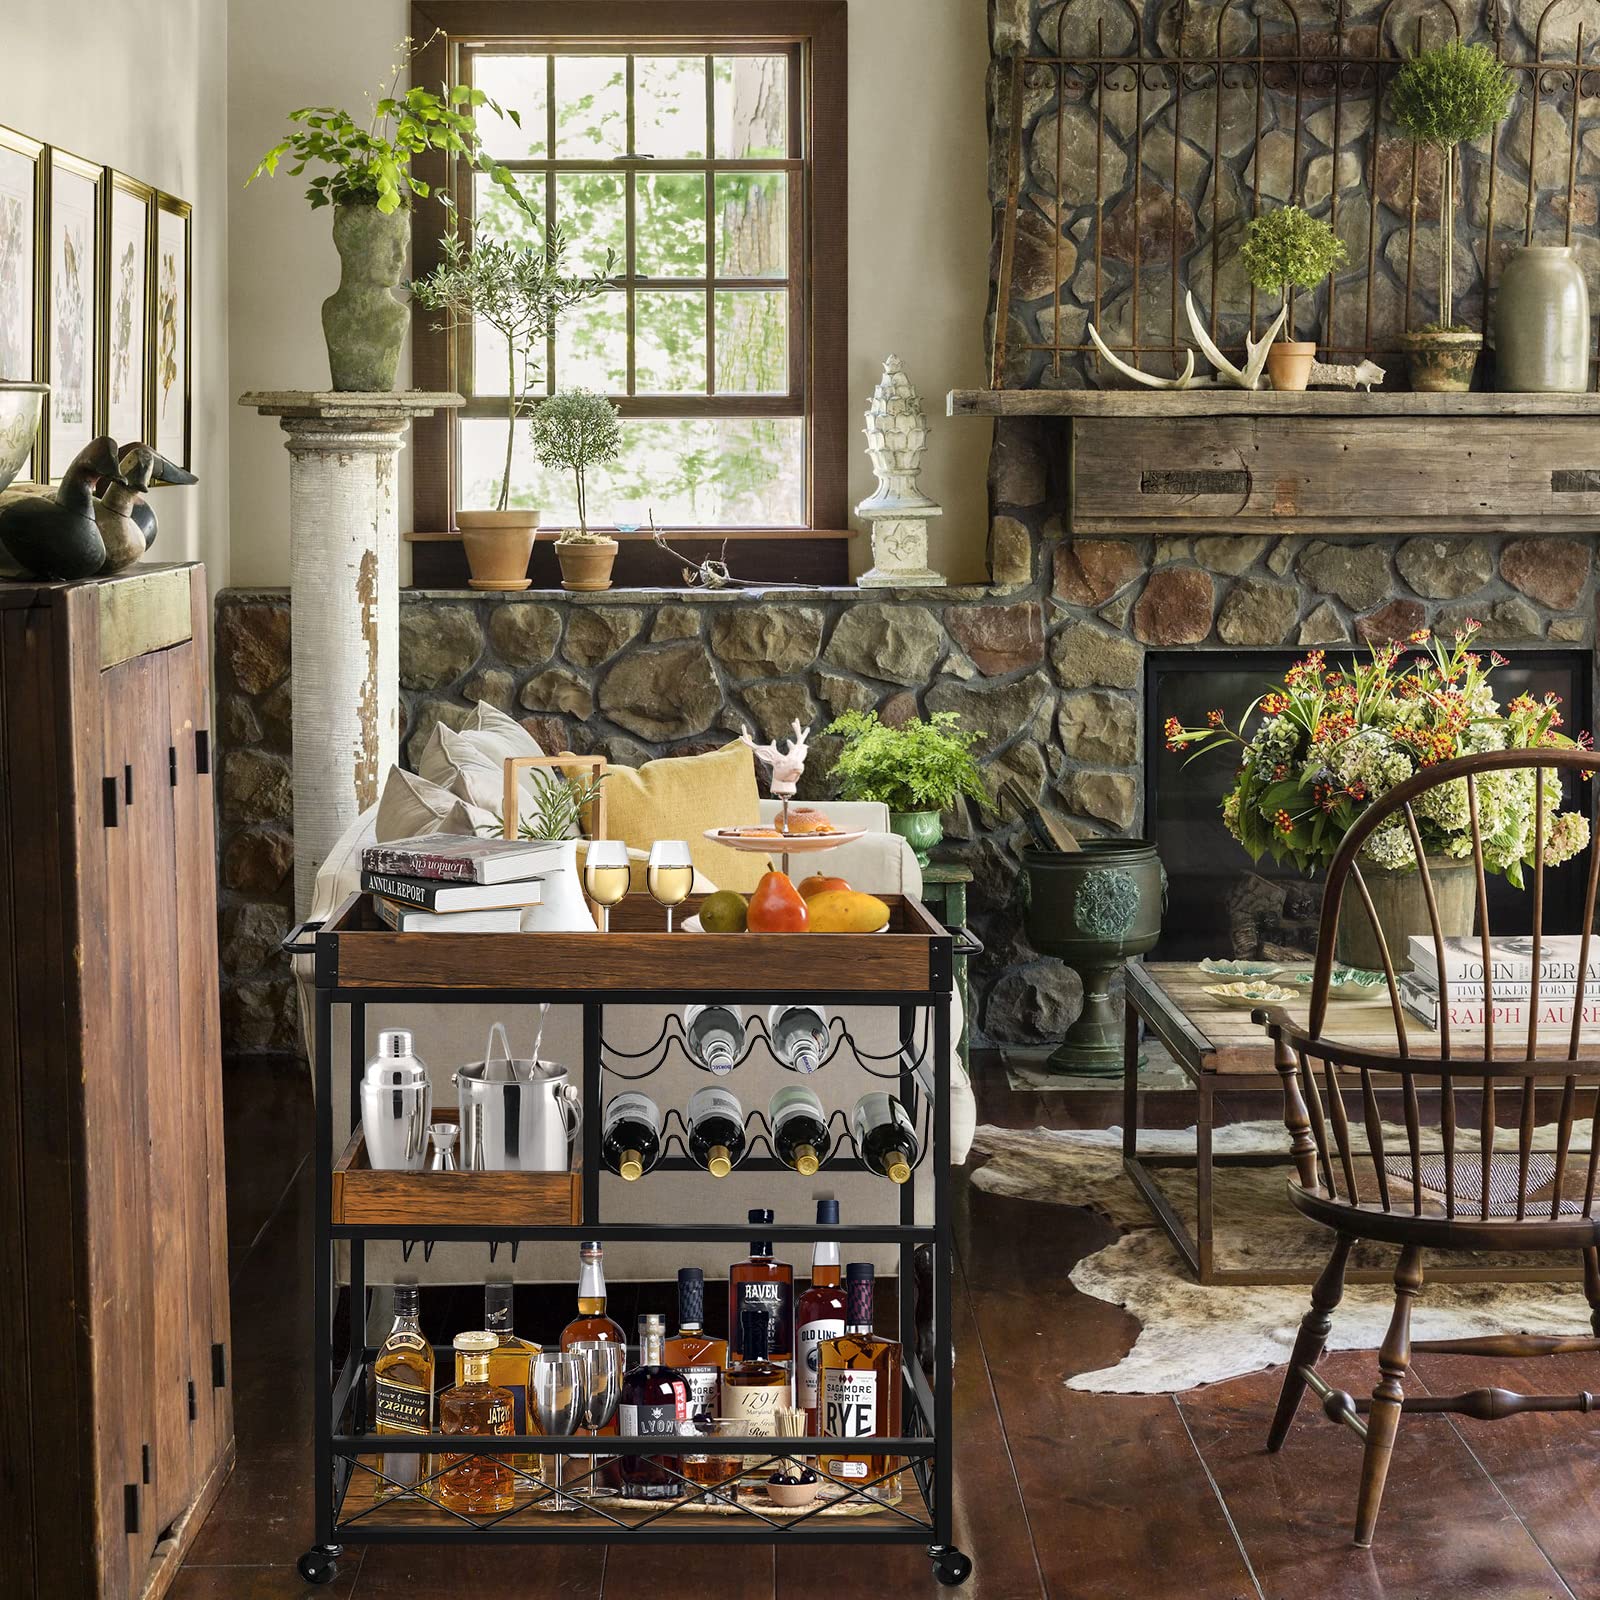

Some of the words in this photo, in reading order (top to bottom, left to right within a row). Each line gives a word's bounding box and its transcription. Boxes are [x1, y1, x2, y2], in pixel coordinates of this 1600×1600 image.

[427, 861, 464, 877] London
[368, 875, 397, 895] ANNUAL
[397, 881, 426, 902] REPORT
[1459, 963, 1514, 980] JOHN
[1540, 984, 1567, 995] TORY
[1537, 1006, 1600, 1024] AURE
[745, 1284, 781, 1301] RAVEN
[801, 1329, 816, 1341] OLD
[826, 1383, 872, 1394] SAGAMORE
[833, 1393, 860, 1402] SPIRIT
[641, 1419, 674, 1434] LYON
[826, 1401, 872, 1438] RYE
